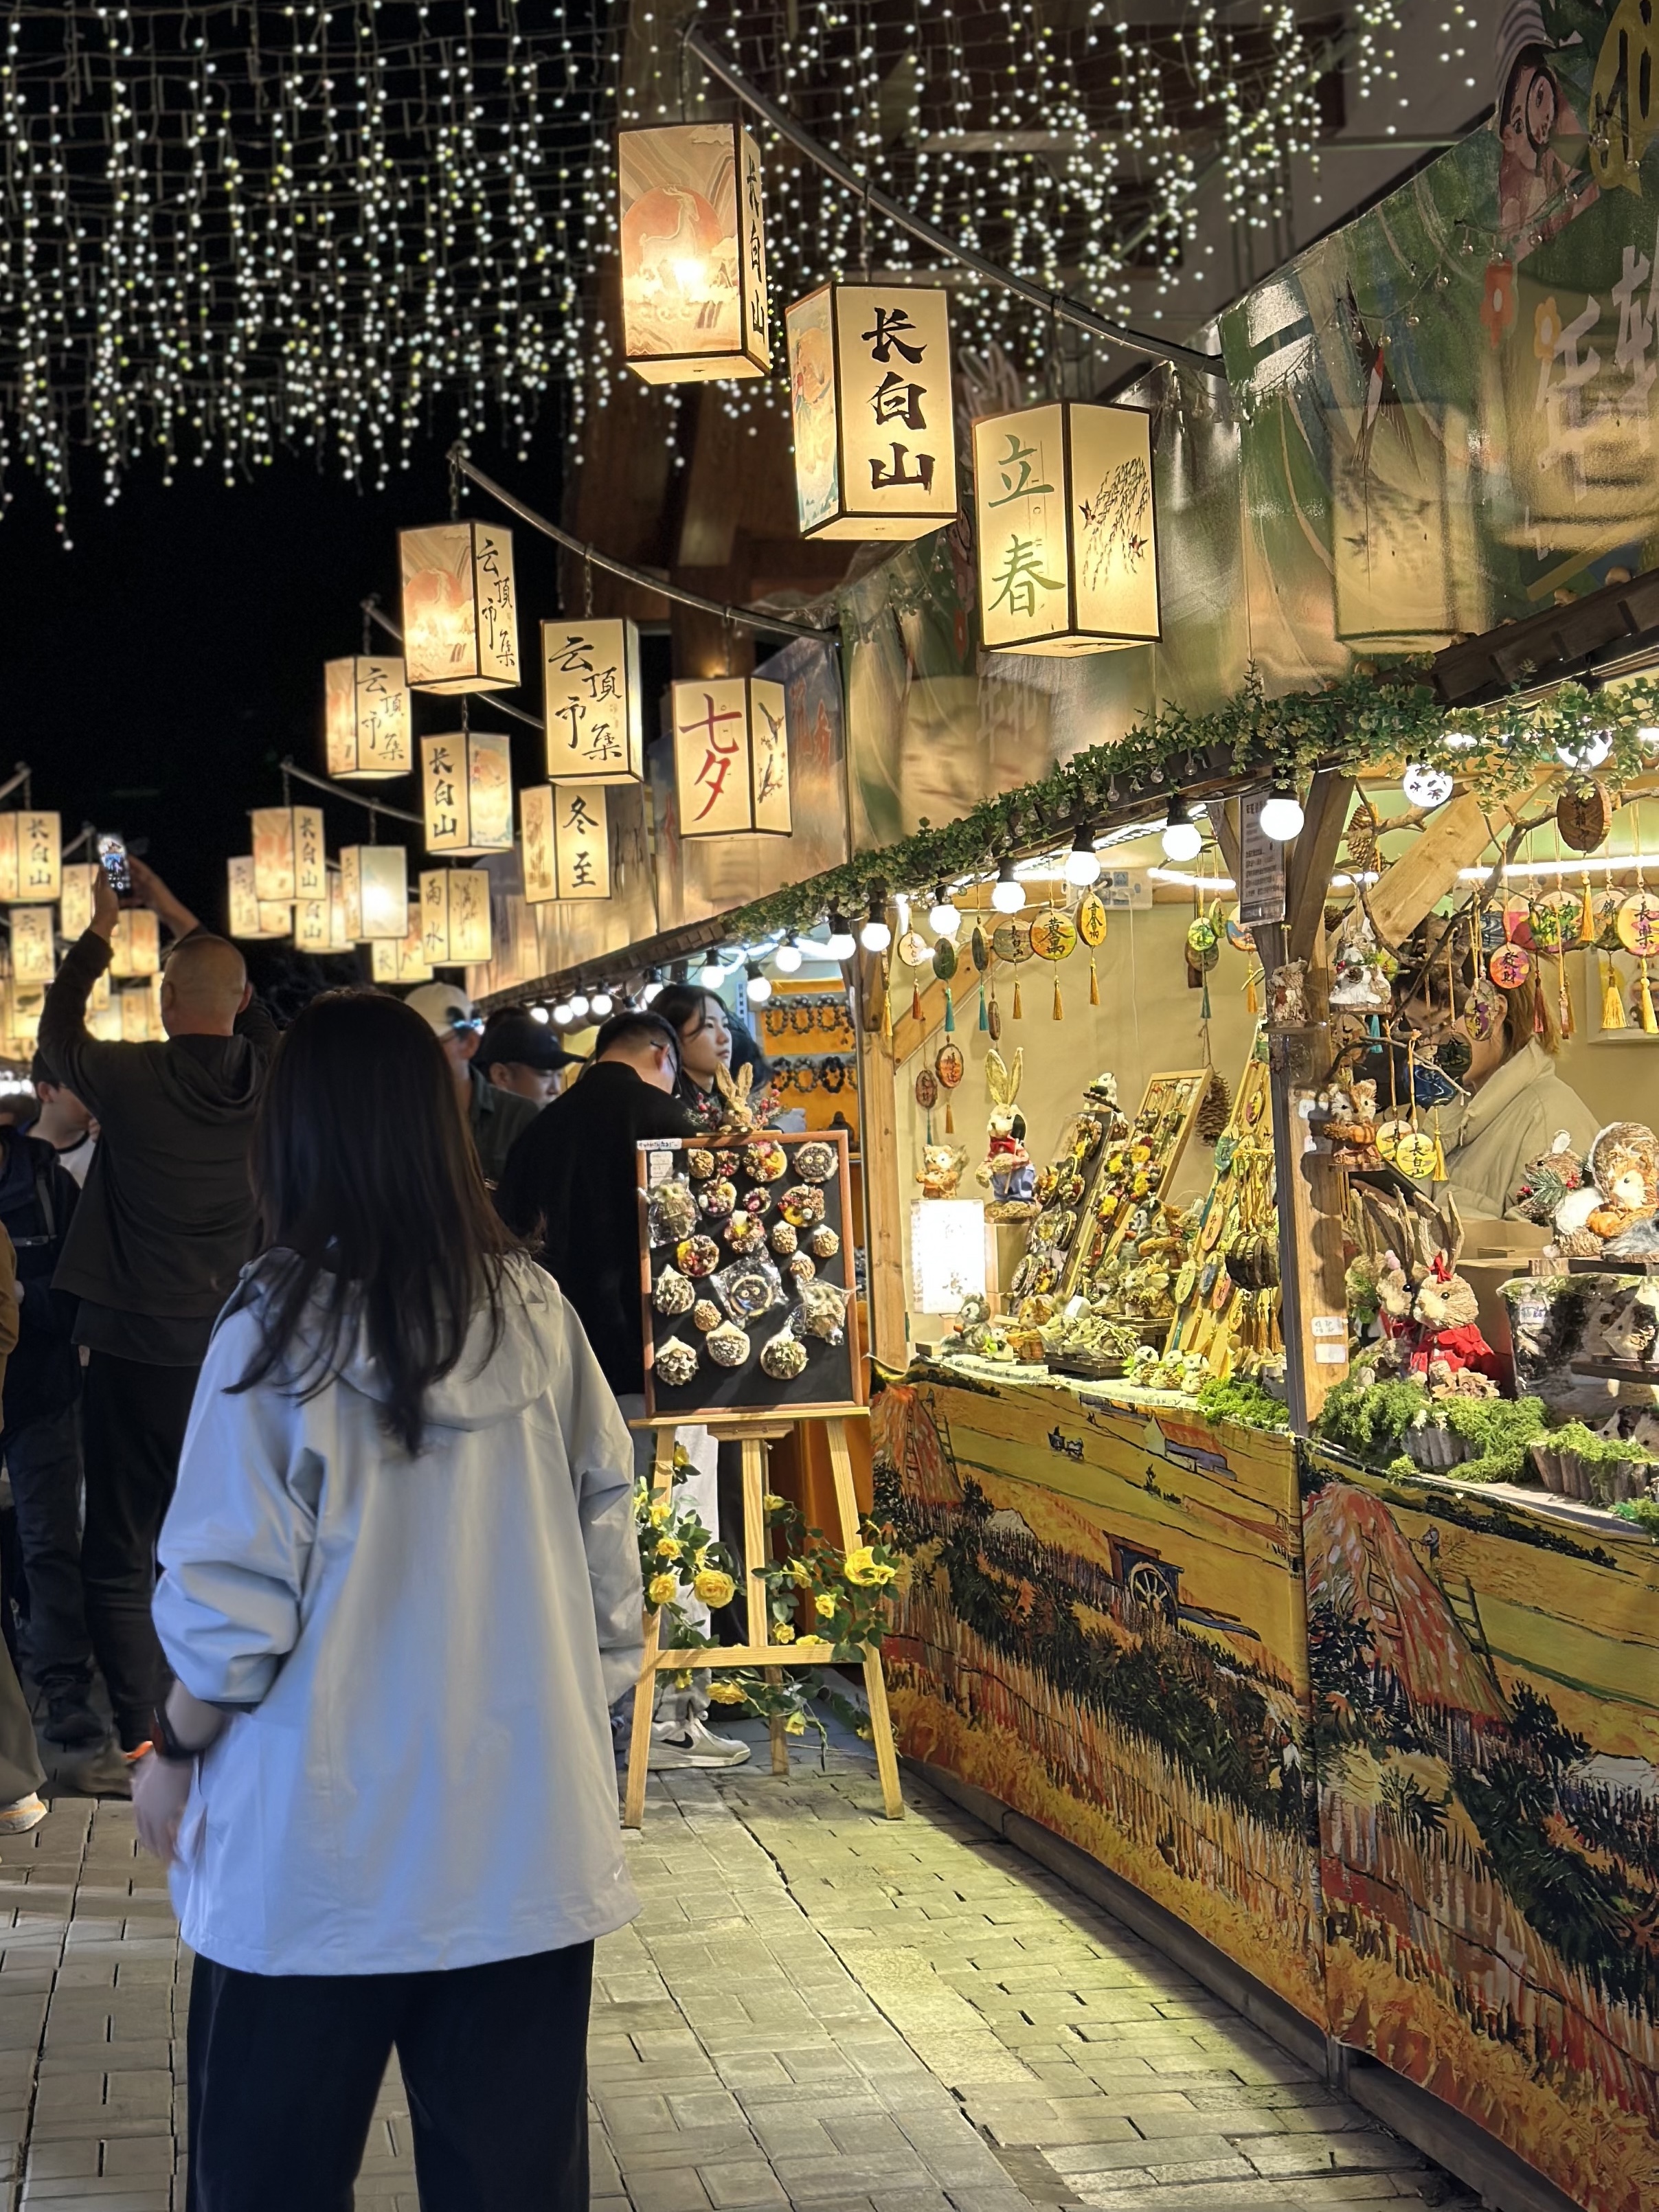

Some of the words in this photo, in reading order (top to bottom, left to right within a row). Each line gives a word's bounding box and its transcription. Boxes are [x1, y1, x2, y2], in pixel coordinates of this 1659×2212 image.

[747, 154, 767, 344] 长白山
[861, 307, 935, 492] 长白山
[988, 434, 1065, 616] 立春
[429, 747, 458, 839] 长白山
[678, 694, 743, 822] 七夕
[27, 818, 52, 886] 长白山
[300, 816, 317, 888] 长白山
[563, 795, 598, 888] 冬至
[426, 879, 444, 951] 雨水
